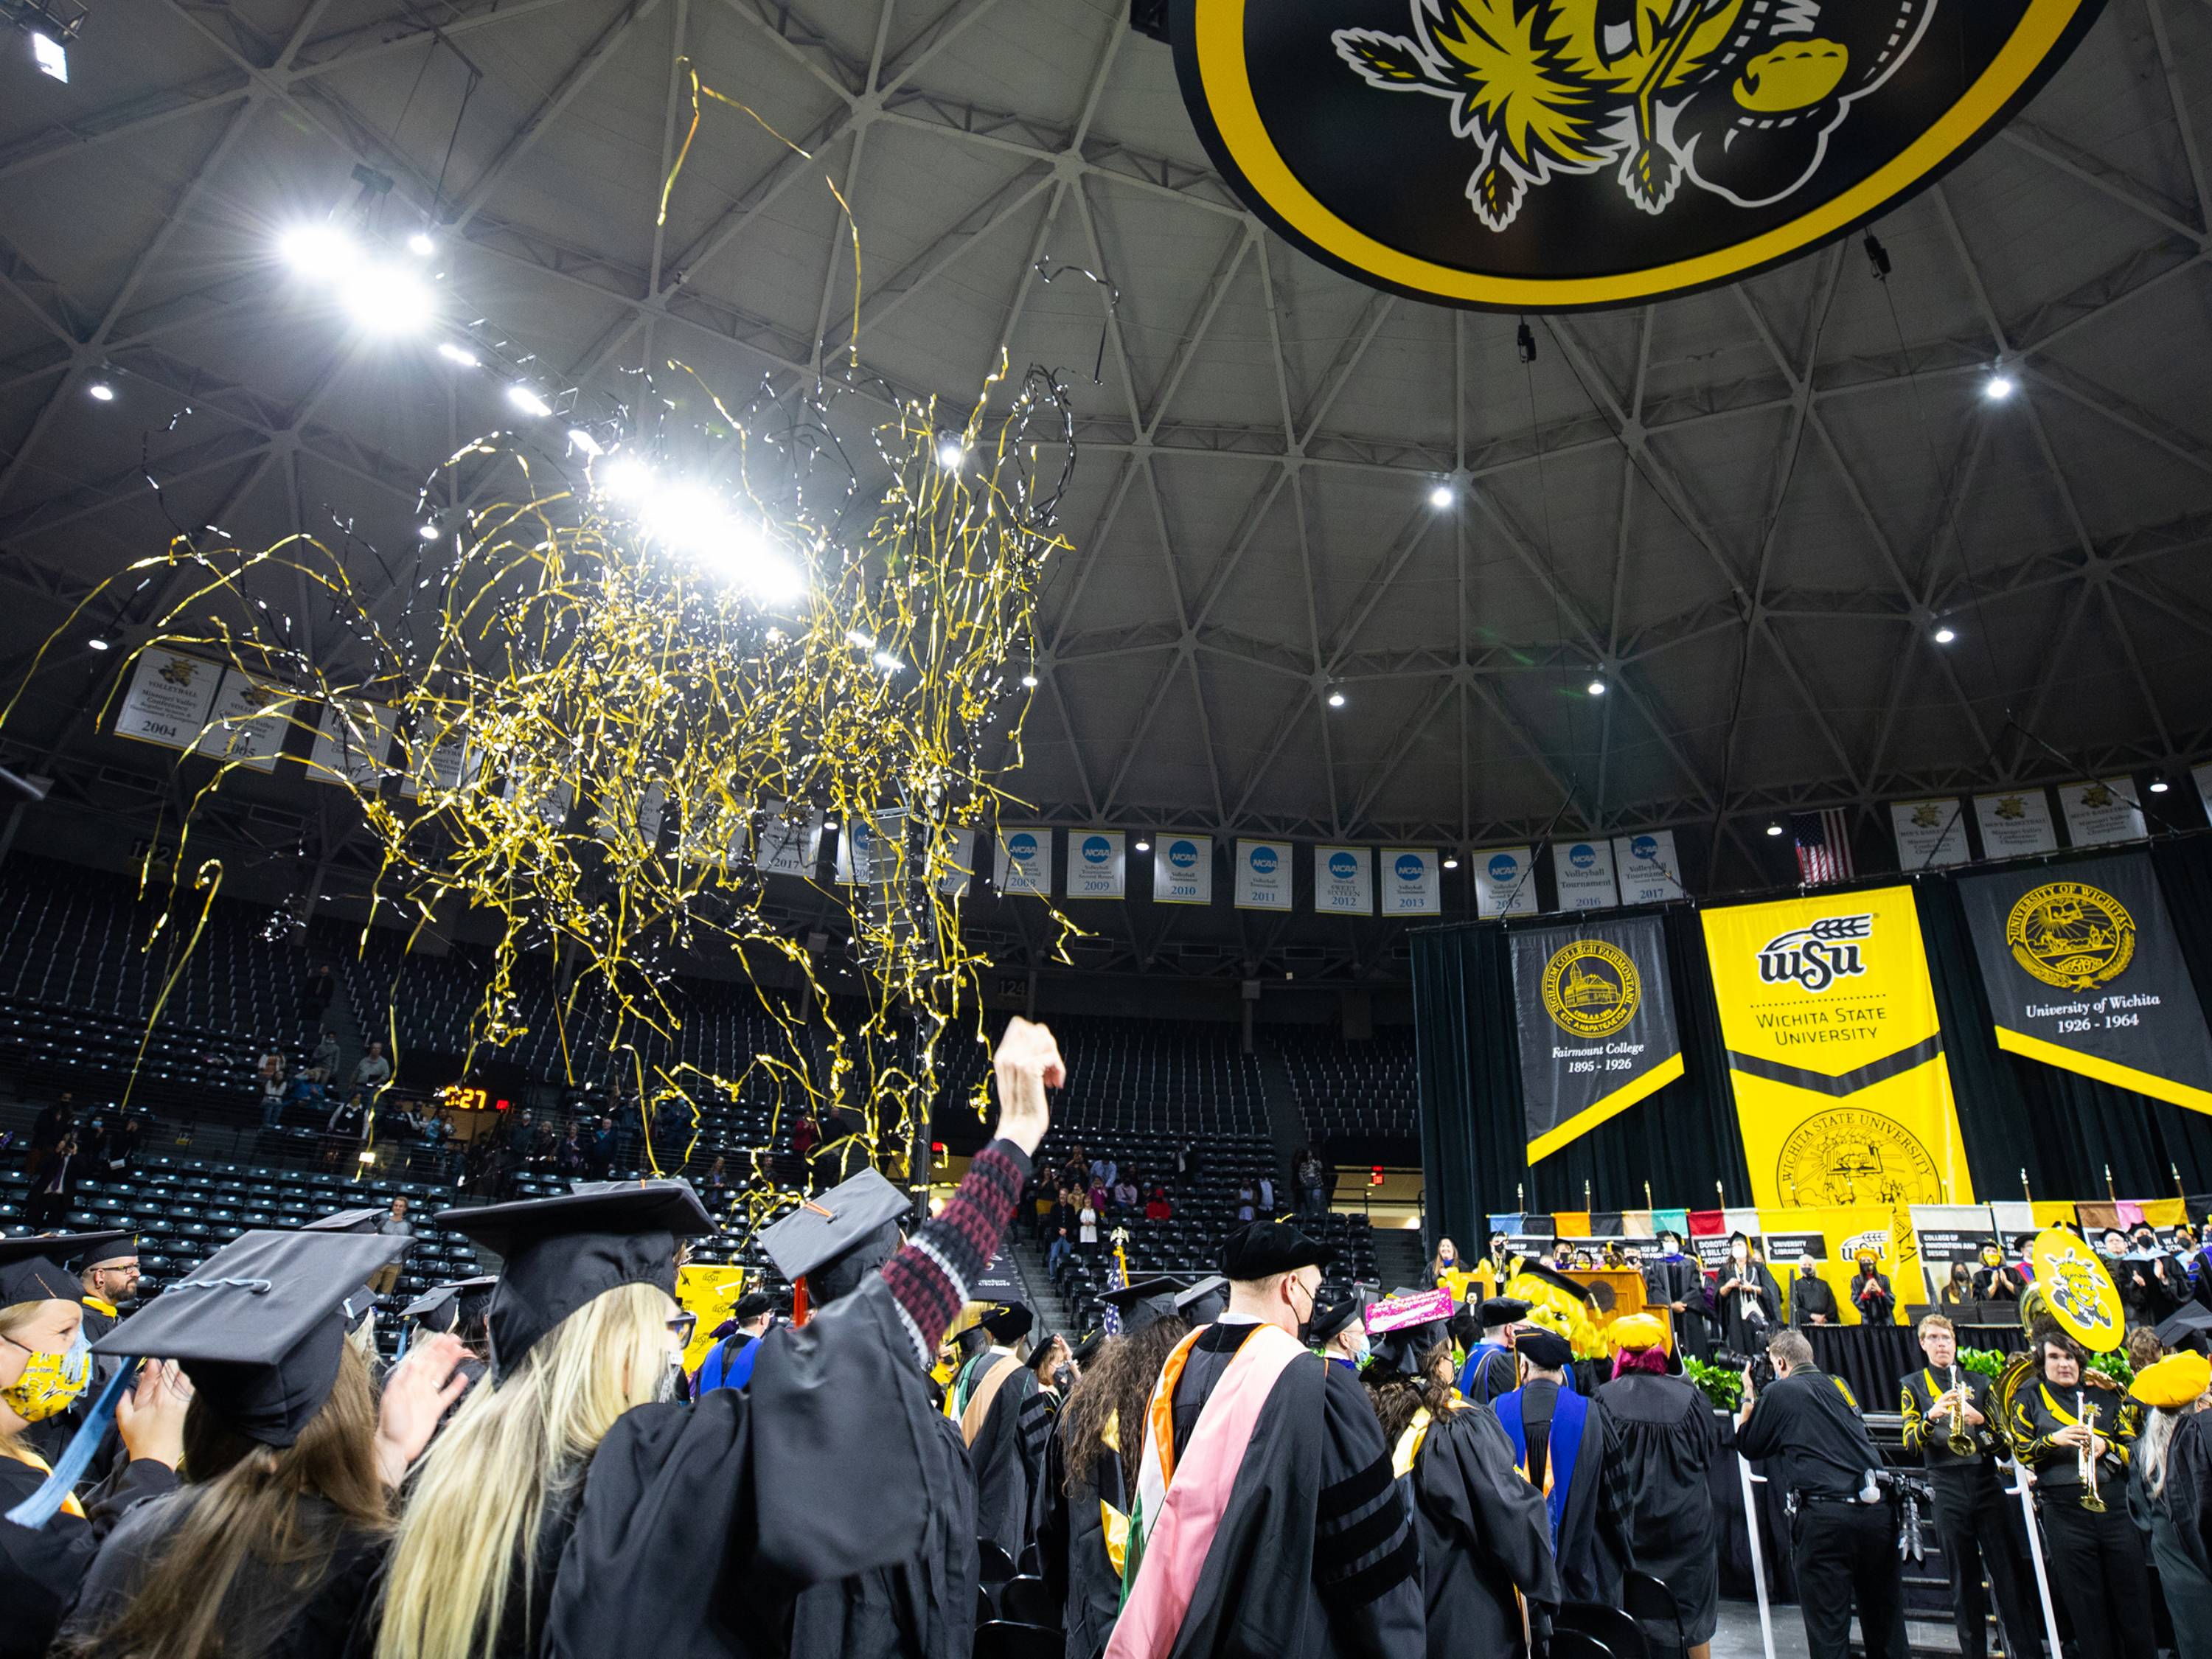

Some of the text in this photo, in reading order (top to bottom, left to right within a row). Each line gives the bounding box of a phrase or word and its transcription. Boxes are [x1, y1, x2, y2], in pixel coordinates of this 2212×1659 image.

[148, 680, 198, 698] VOLLEYBALL
[175, 696, 197, 709] Valley
[142, 720, 177, 737] 2004
[1085, 849, 1111, 857] NCAA
[1172, 852, 1197, 862] NCAA
[774, 858, 799, 869] 2017
[1253, 859, 1278, 868] NCAA
[1572, 855, 1596, 863] NCAA
[1332, 865, 1357, 873] NCAA
[1398, 867, 1424, 875] NCAA
[1492, 866, 1517, 876] NCAA
[1565, 868, 1604, 878] Volleyball
[1084, 881, 1110, 891] 2009
[1561, 879, 1612, 889] Tournament
[1171, 886, 1196, 896] 2010
[1252, 891, 1276, 902] 2011
[1640, 888, 1664, 900] 2017
[1332, 896, 1357, 906] 2012
[1399, 897, 1425, 908] 2013
[1575, 897, 1601, 908] 2016
[2010, 886, 2127, 936] UNIVERSITY OF WICHITA
[2025, 993, 2161, 1018] University of Wichita
[2058, 1018, 2091, 1033] 1926
[2105, 1013, 2139, 1029] 1964
[1552, 1041, 1645, 1059] Fairmount College
[1568, 1060, 1595, 1074] 1895
[1605, 1057, 1632, 1071] 1926
[1782, 1113, 1932, 1182] WICHITA STATE UNIVERSITY
[1923, 1234, 1950, 1242] COLLEGE
